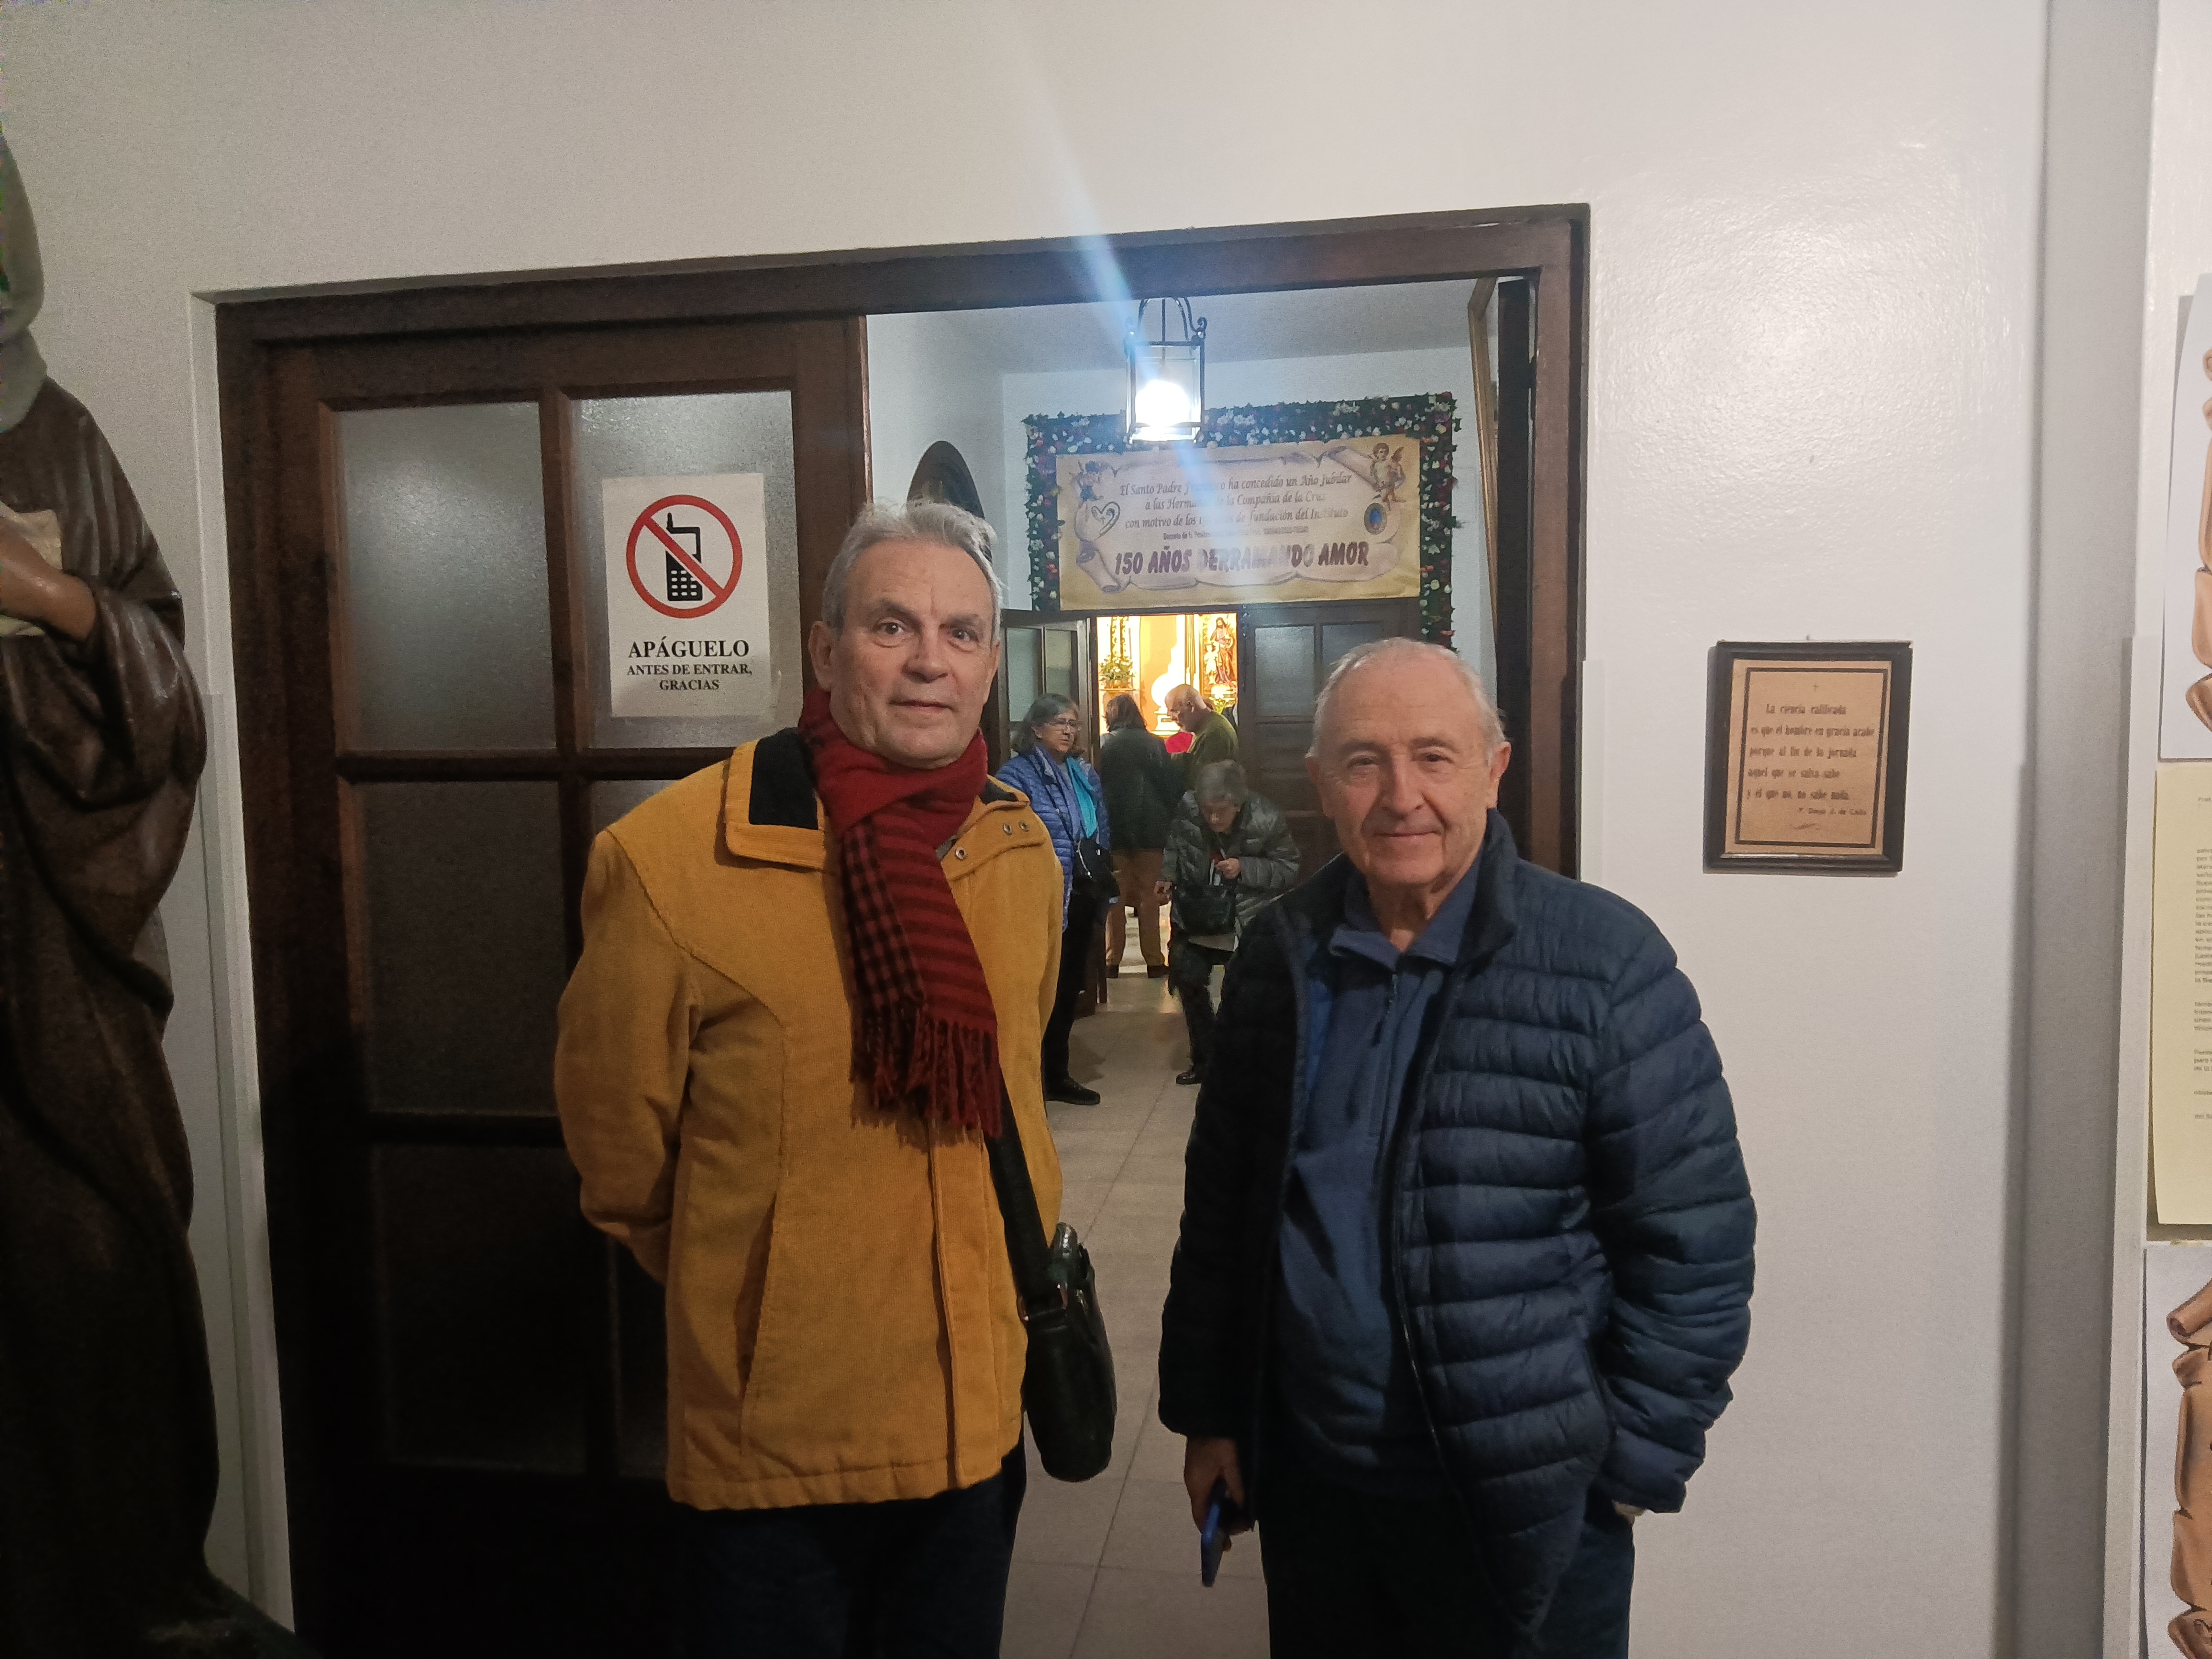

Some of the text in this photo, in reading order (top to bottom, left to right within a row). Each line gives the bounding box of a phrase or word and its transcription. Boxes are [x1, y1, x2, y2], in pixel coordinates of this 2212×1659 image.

[1120, 483, 1130, 496] El
[1130, 484, 1154, 495] Santo
[1156, 481, 1182, 494] Padre
[1228, 477, 1239, 489] ha
[1286, 478, 1297, 487] un
[1300, 475, 1319, 487] Año
[1153, 497, 1164, 510] las
[1283, 490, 1293, 503] de
[1126, 520, 1140, 528] con
[1142, 517, 1172, 527] motivo
[1173, 514, 1183, 526] de
[1185, 513, 1196, 526] los
[1295, 507, 1309, 520] del
[1115, 552, 1143, 575] 150
[1148, 545, 1192, 574] AÑOS
[1317, 541, 1370, 566] AMOR
[628, 635, 749, 658] APÁGUELO
[627, 664, 752, 675] ANTES DE ENTRAR,
[659, 679, 720, 690] GRACIAS
[1766, 703, 1775, 714] La
